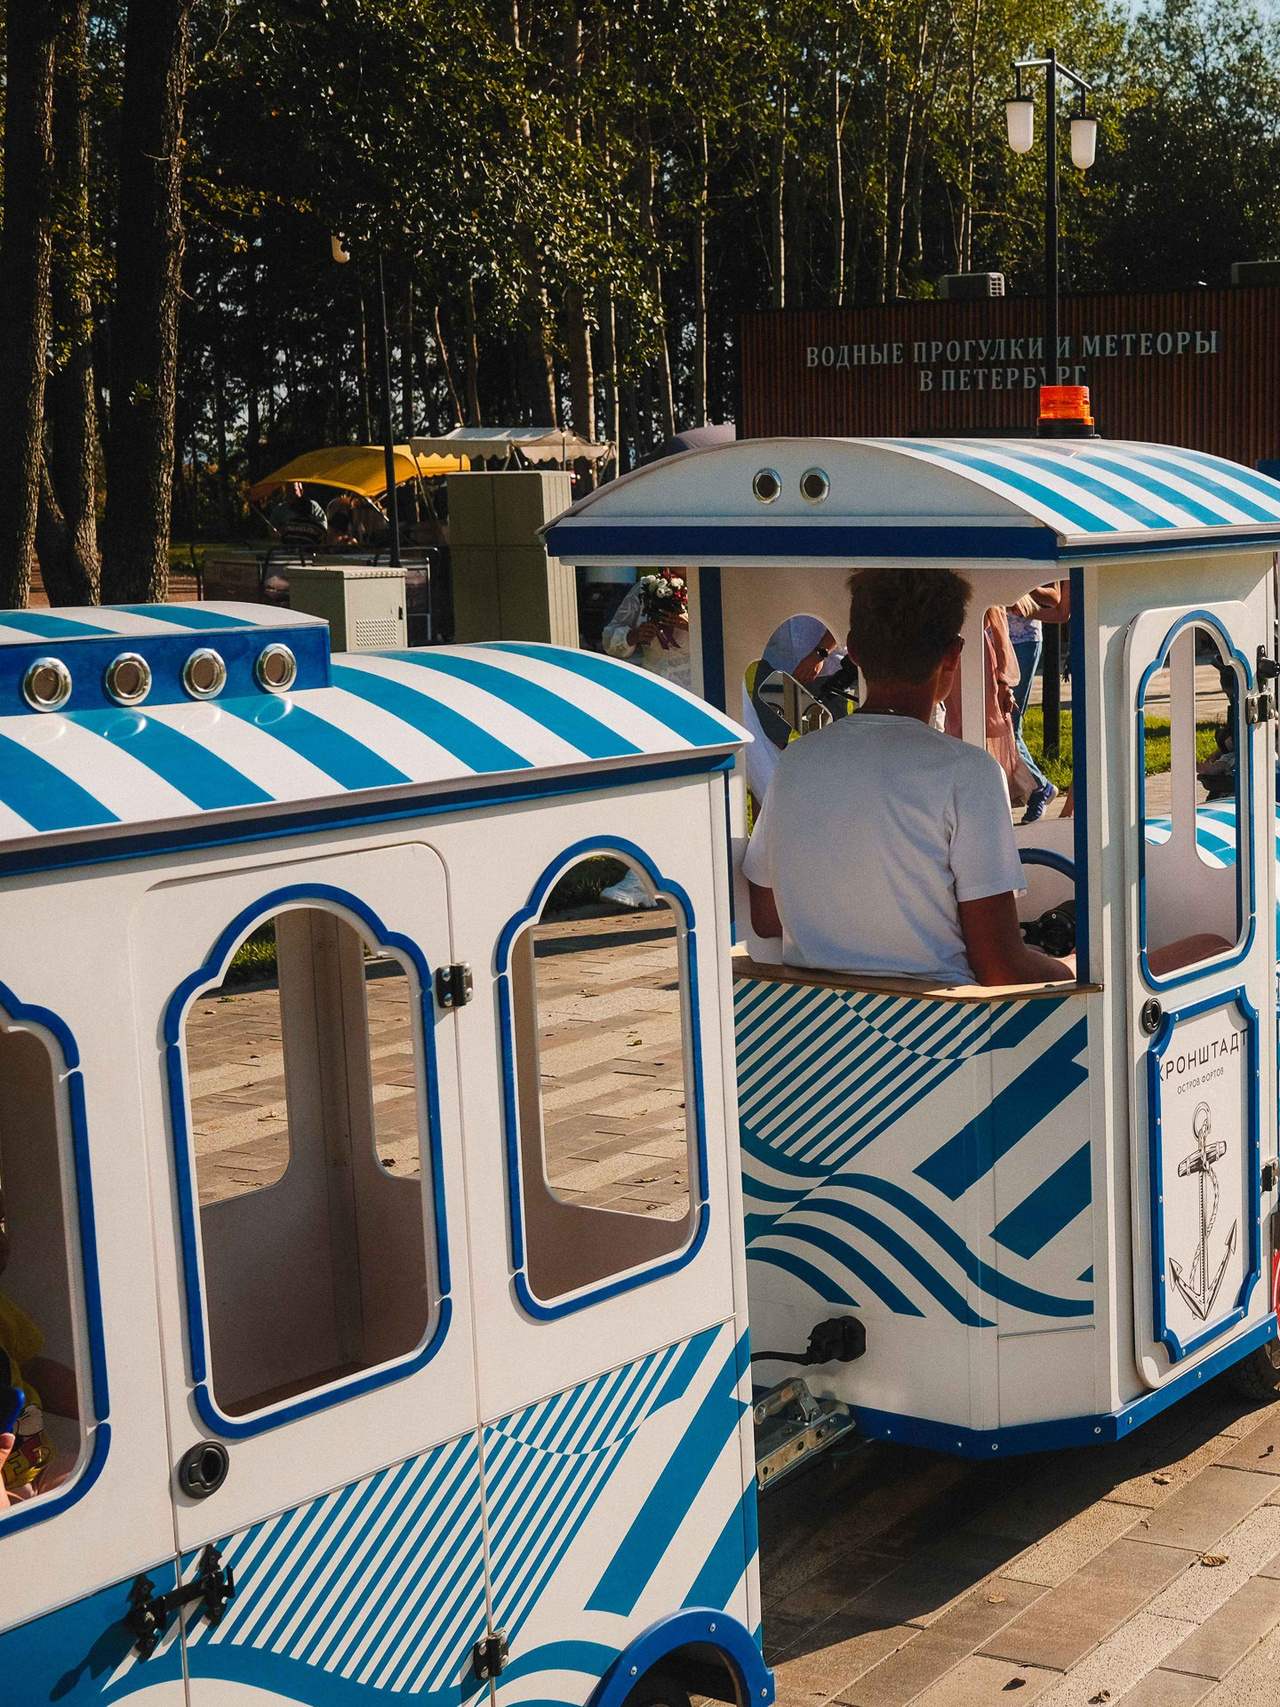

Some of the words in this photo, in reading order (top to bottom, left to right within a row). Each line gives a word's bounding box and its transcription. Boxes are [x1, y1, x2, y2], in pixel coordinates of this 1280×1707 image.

[806, 342, 904, 371] ВОДНЫЕ
[913, 337, 1043, 364] ПРОГУЛКИ
[1056, 336, 1071, 358] И
[1082, 330, 1217, 358] МЕТЕОРЫ
[919, 370, 933, 392] В
[1177, 1077, 1201, 1095] ОСТРОВ
[1201, 1067, 1224, 1083] ФОРТОВ
